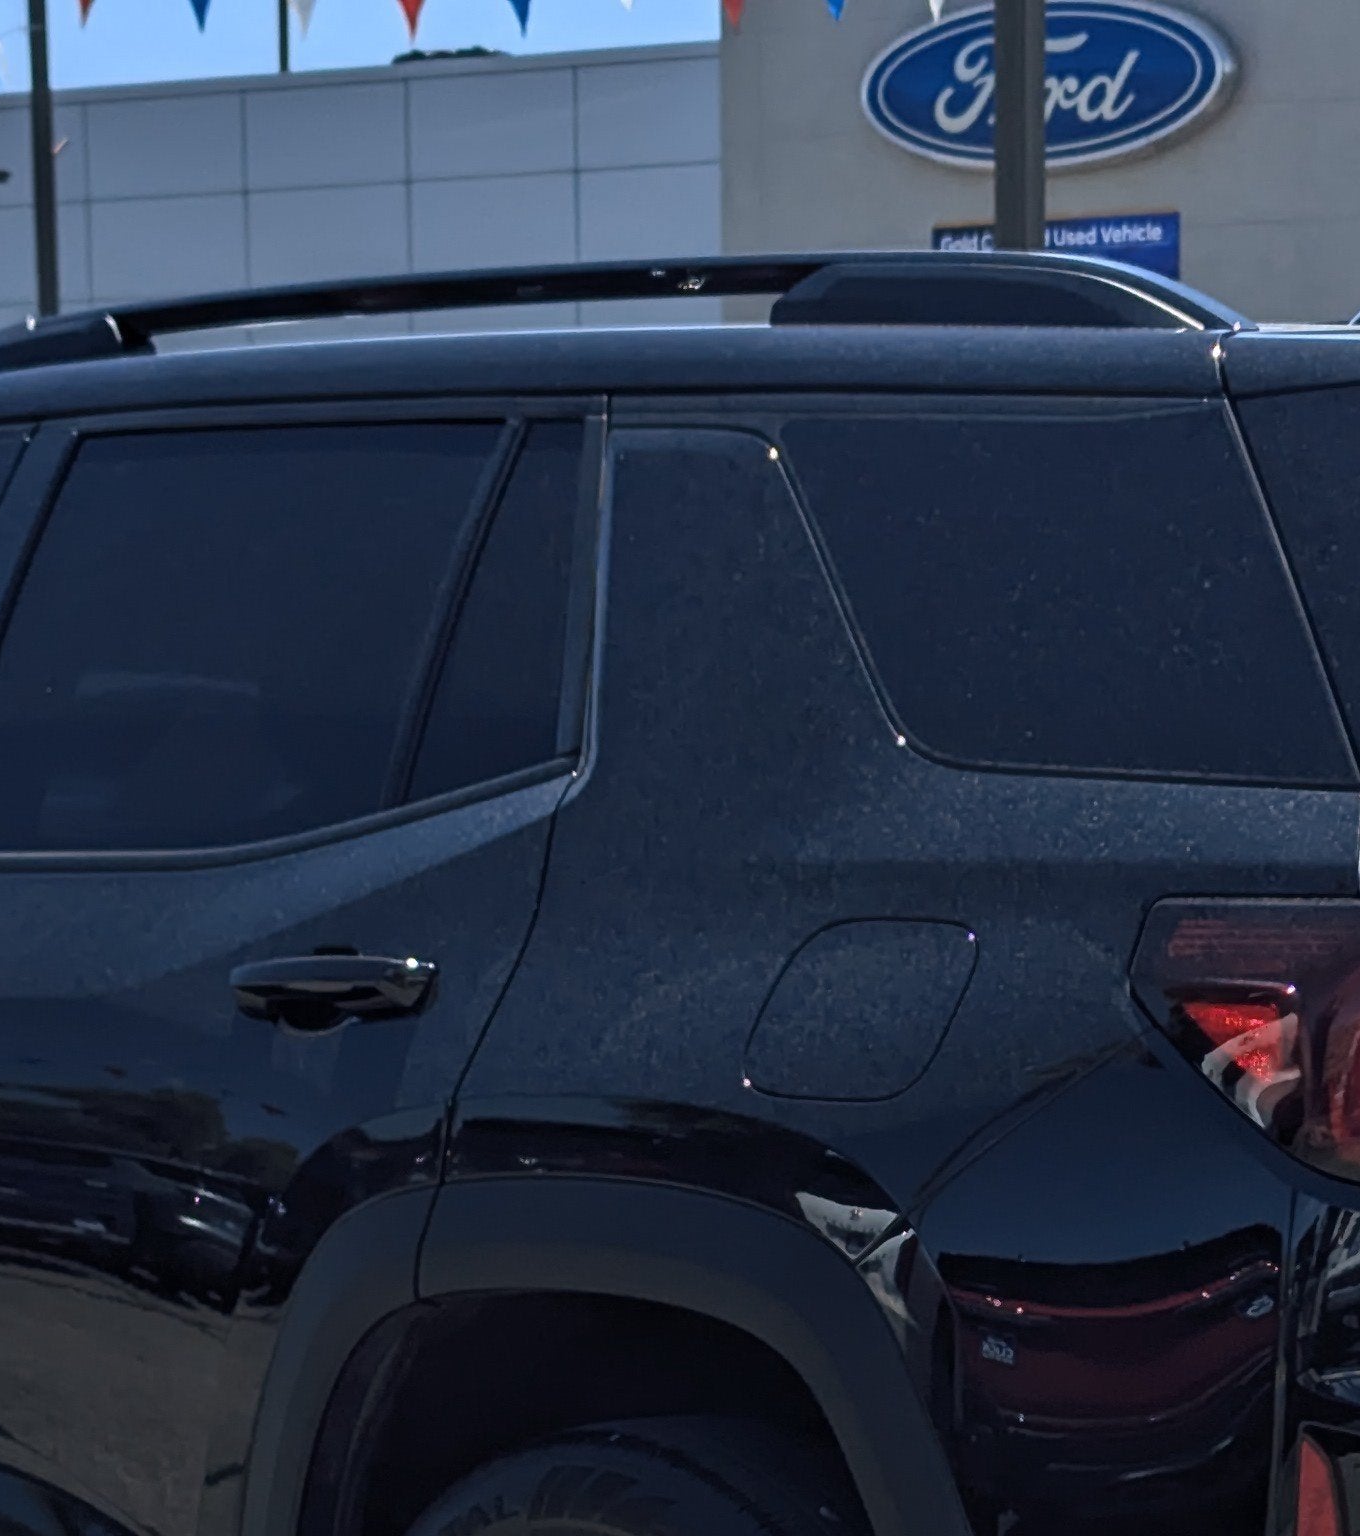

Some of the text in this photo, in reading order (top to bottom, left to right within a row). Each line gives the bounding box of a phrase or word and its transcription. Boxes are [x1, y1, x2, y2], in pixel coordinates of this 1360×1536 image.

[934, 32, 1140, 134] Frd
[1053, 225, 1096, 247] Used
[1099, 221, 1163, 244] Vehicle
